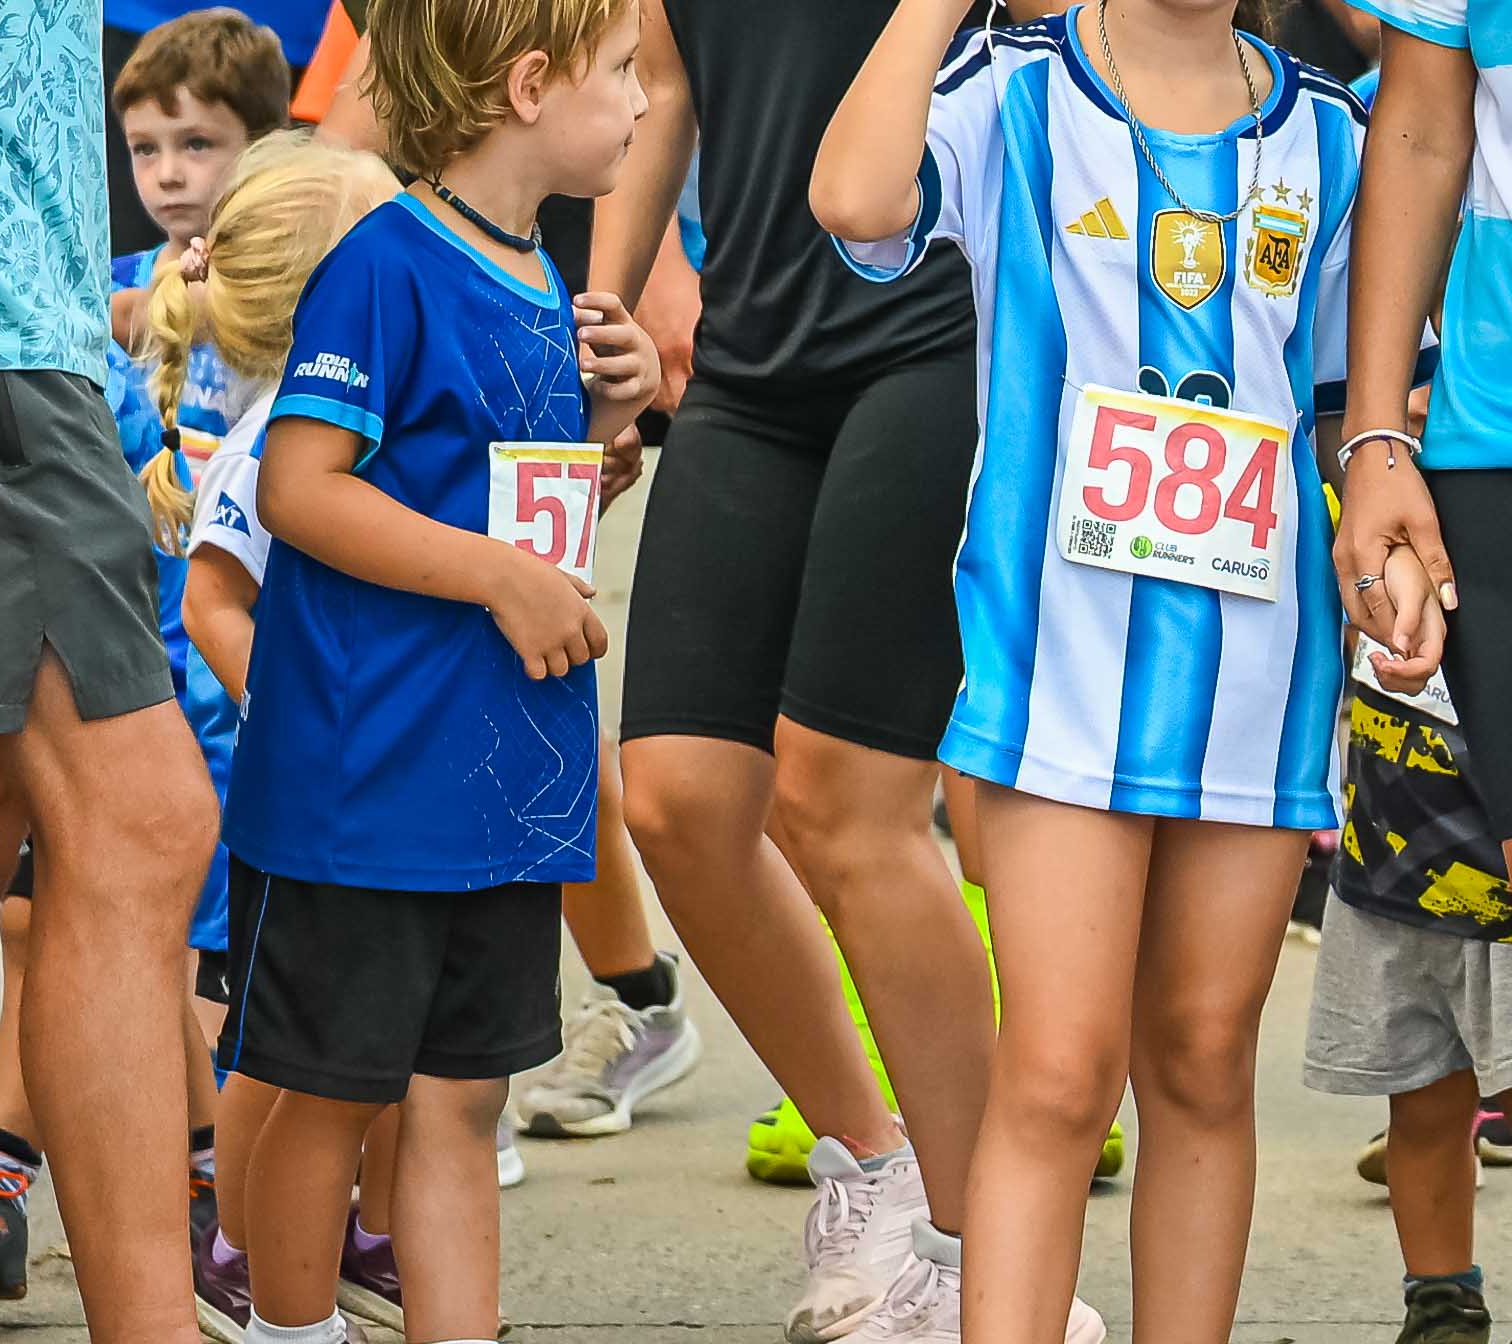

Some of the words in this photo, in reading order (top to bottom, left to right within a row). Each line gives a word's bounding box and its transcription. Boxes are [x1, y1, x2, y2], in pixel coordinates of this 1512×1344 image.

[1259, 232, 1291, 275] AFA
[1173, 271, 1206, 284] FIFA
[1082, 405, 1280, 551] 584
[1211, 557, 1269, 581] CARUSO
